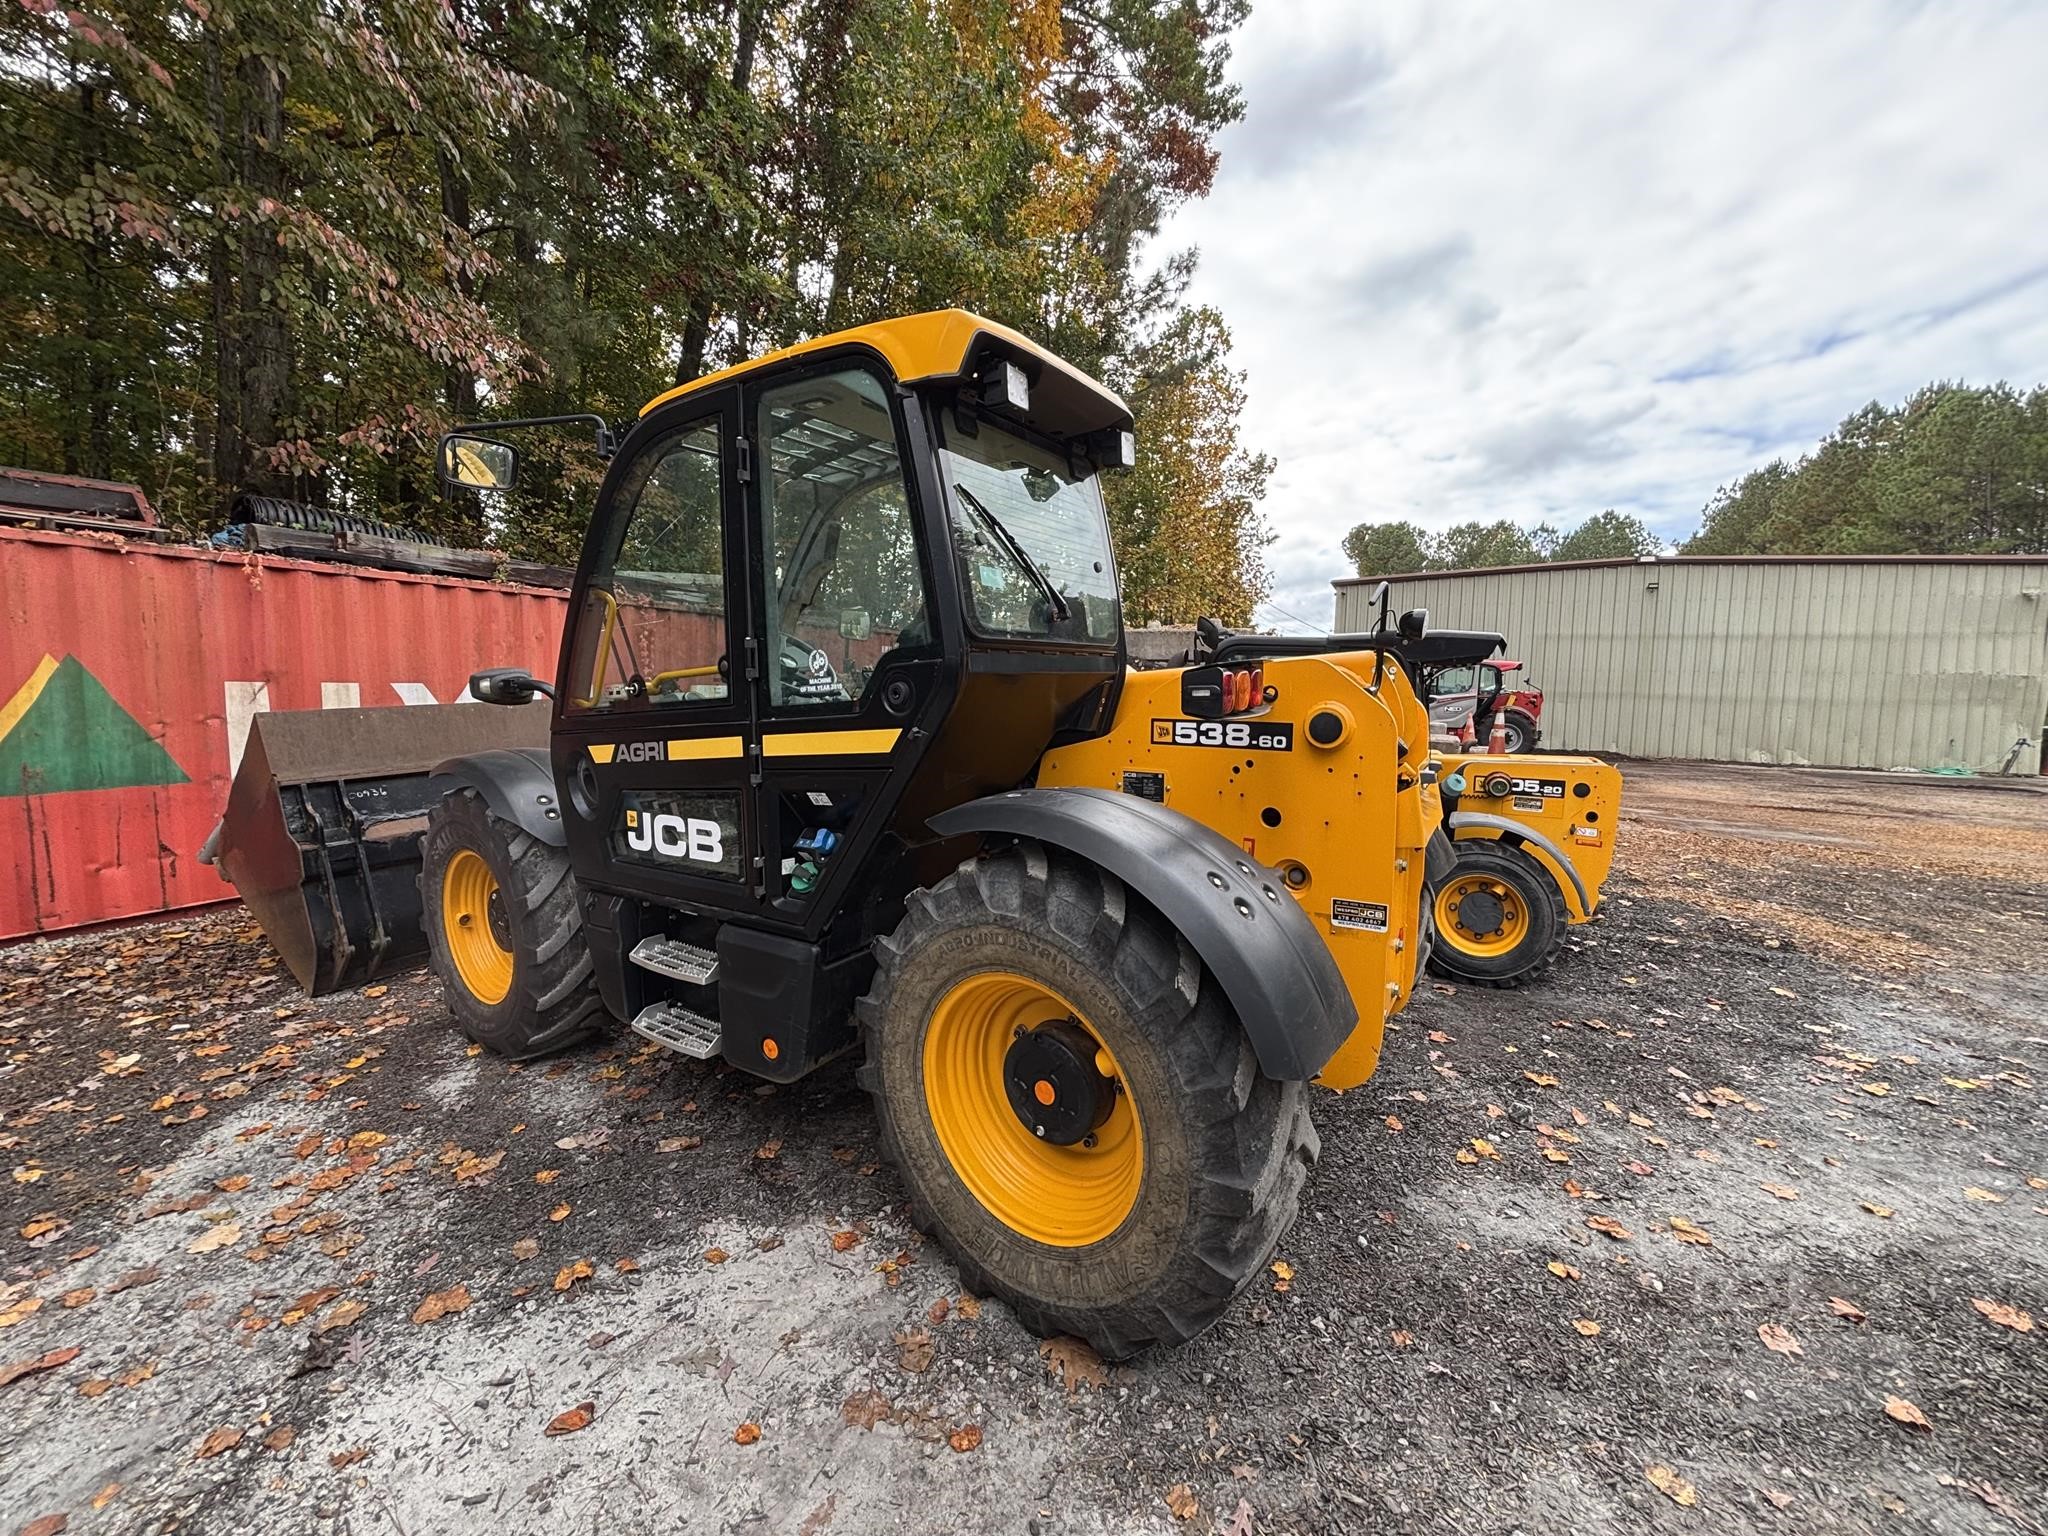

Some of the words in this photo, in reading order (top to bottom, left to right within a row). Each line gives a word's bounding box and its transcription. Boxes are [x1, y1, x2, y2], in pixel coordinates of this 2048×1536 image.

[1156, 725, 1170, 738] JCB
[1174, 722, 1287, 749] 538-60
[615, 741, 665, 763] AGRI
[627, 812, 723, 863] JCB
[1360, 910, 1384, 918] JCB
